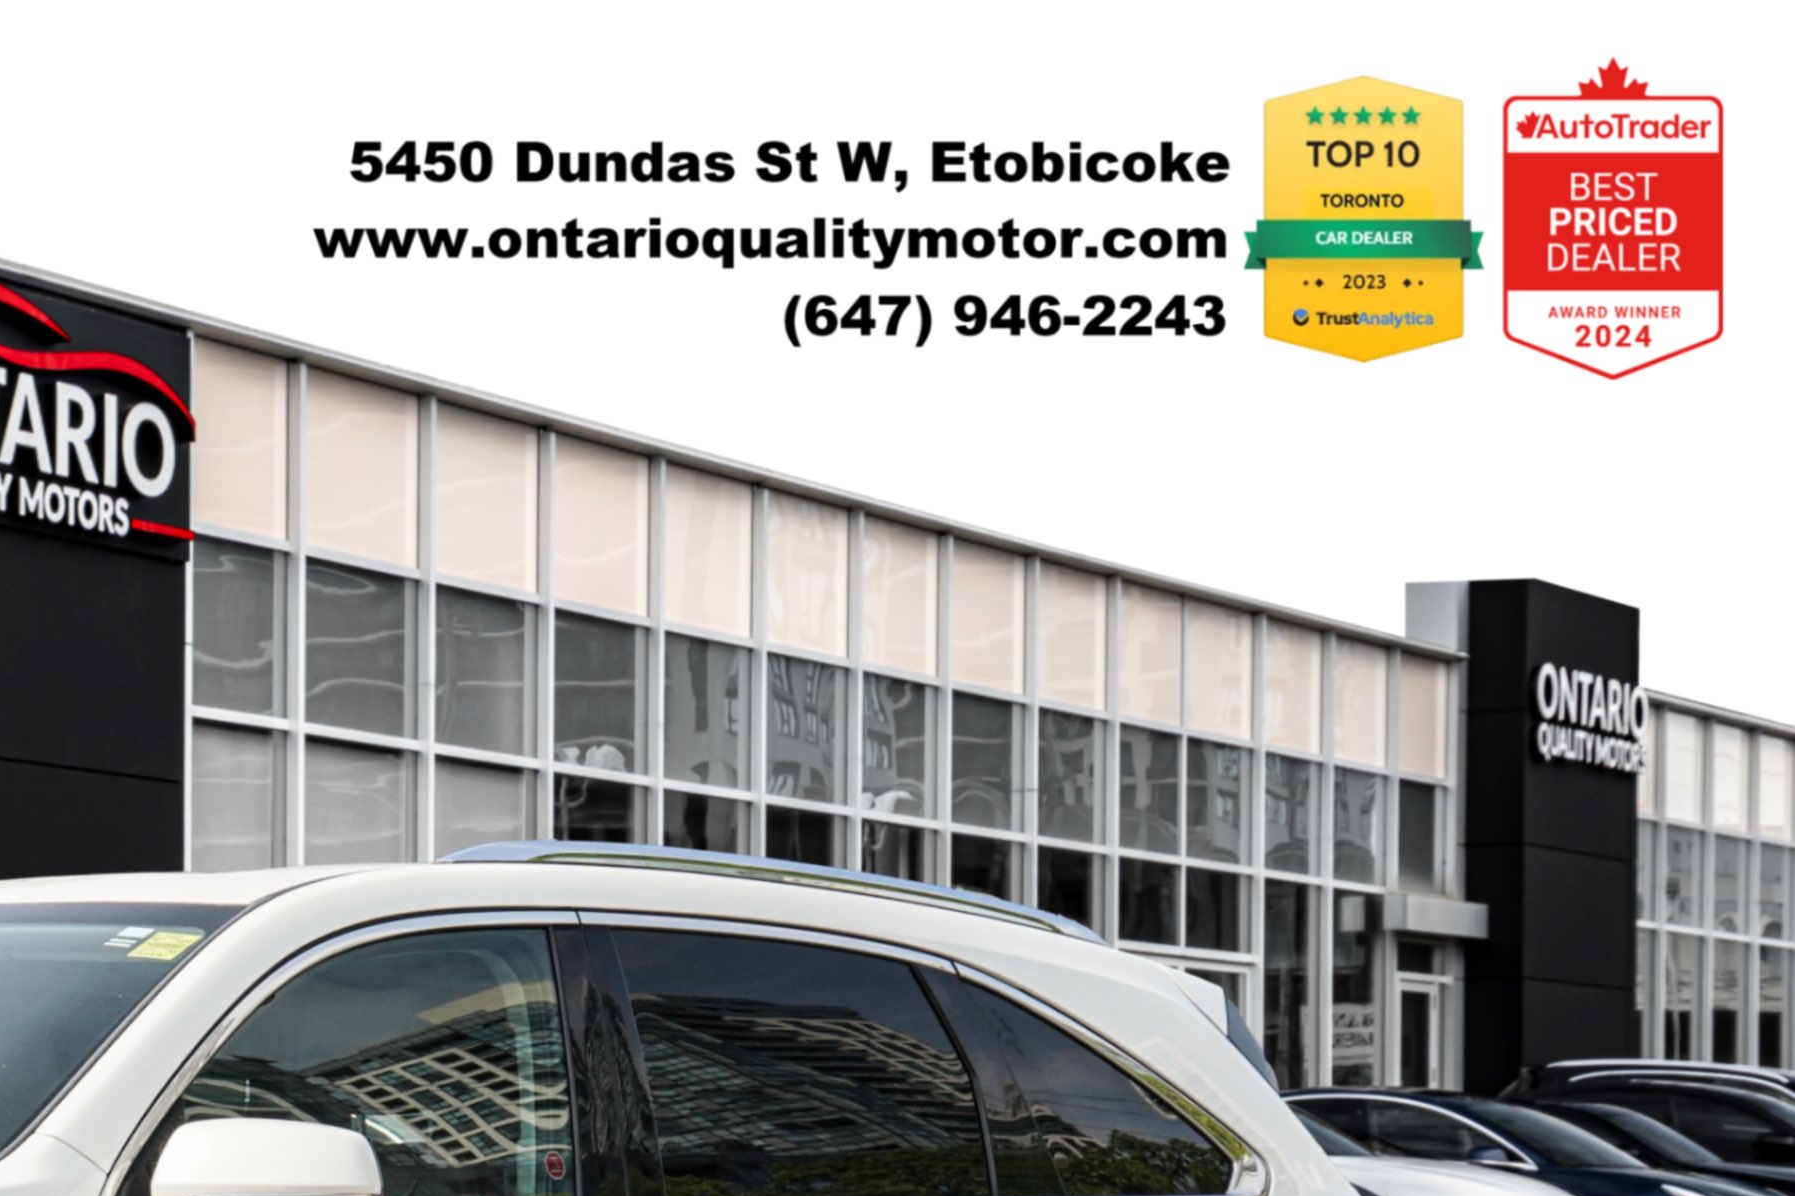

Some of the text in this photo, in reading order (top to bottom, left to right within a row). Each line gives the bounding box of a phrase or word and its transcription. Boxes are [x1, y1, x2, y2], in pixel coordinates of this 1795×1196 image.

[19, 476, 130, 536] MOTORS
[1537, 662, 1648, 738] ONTARIO
[1537, 721, 1595, 763] QUALITY
